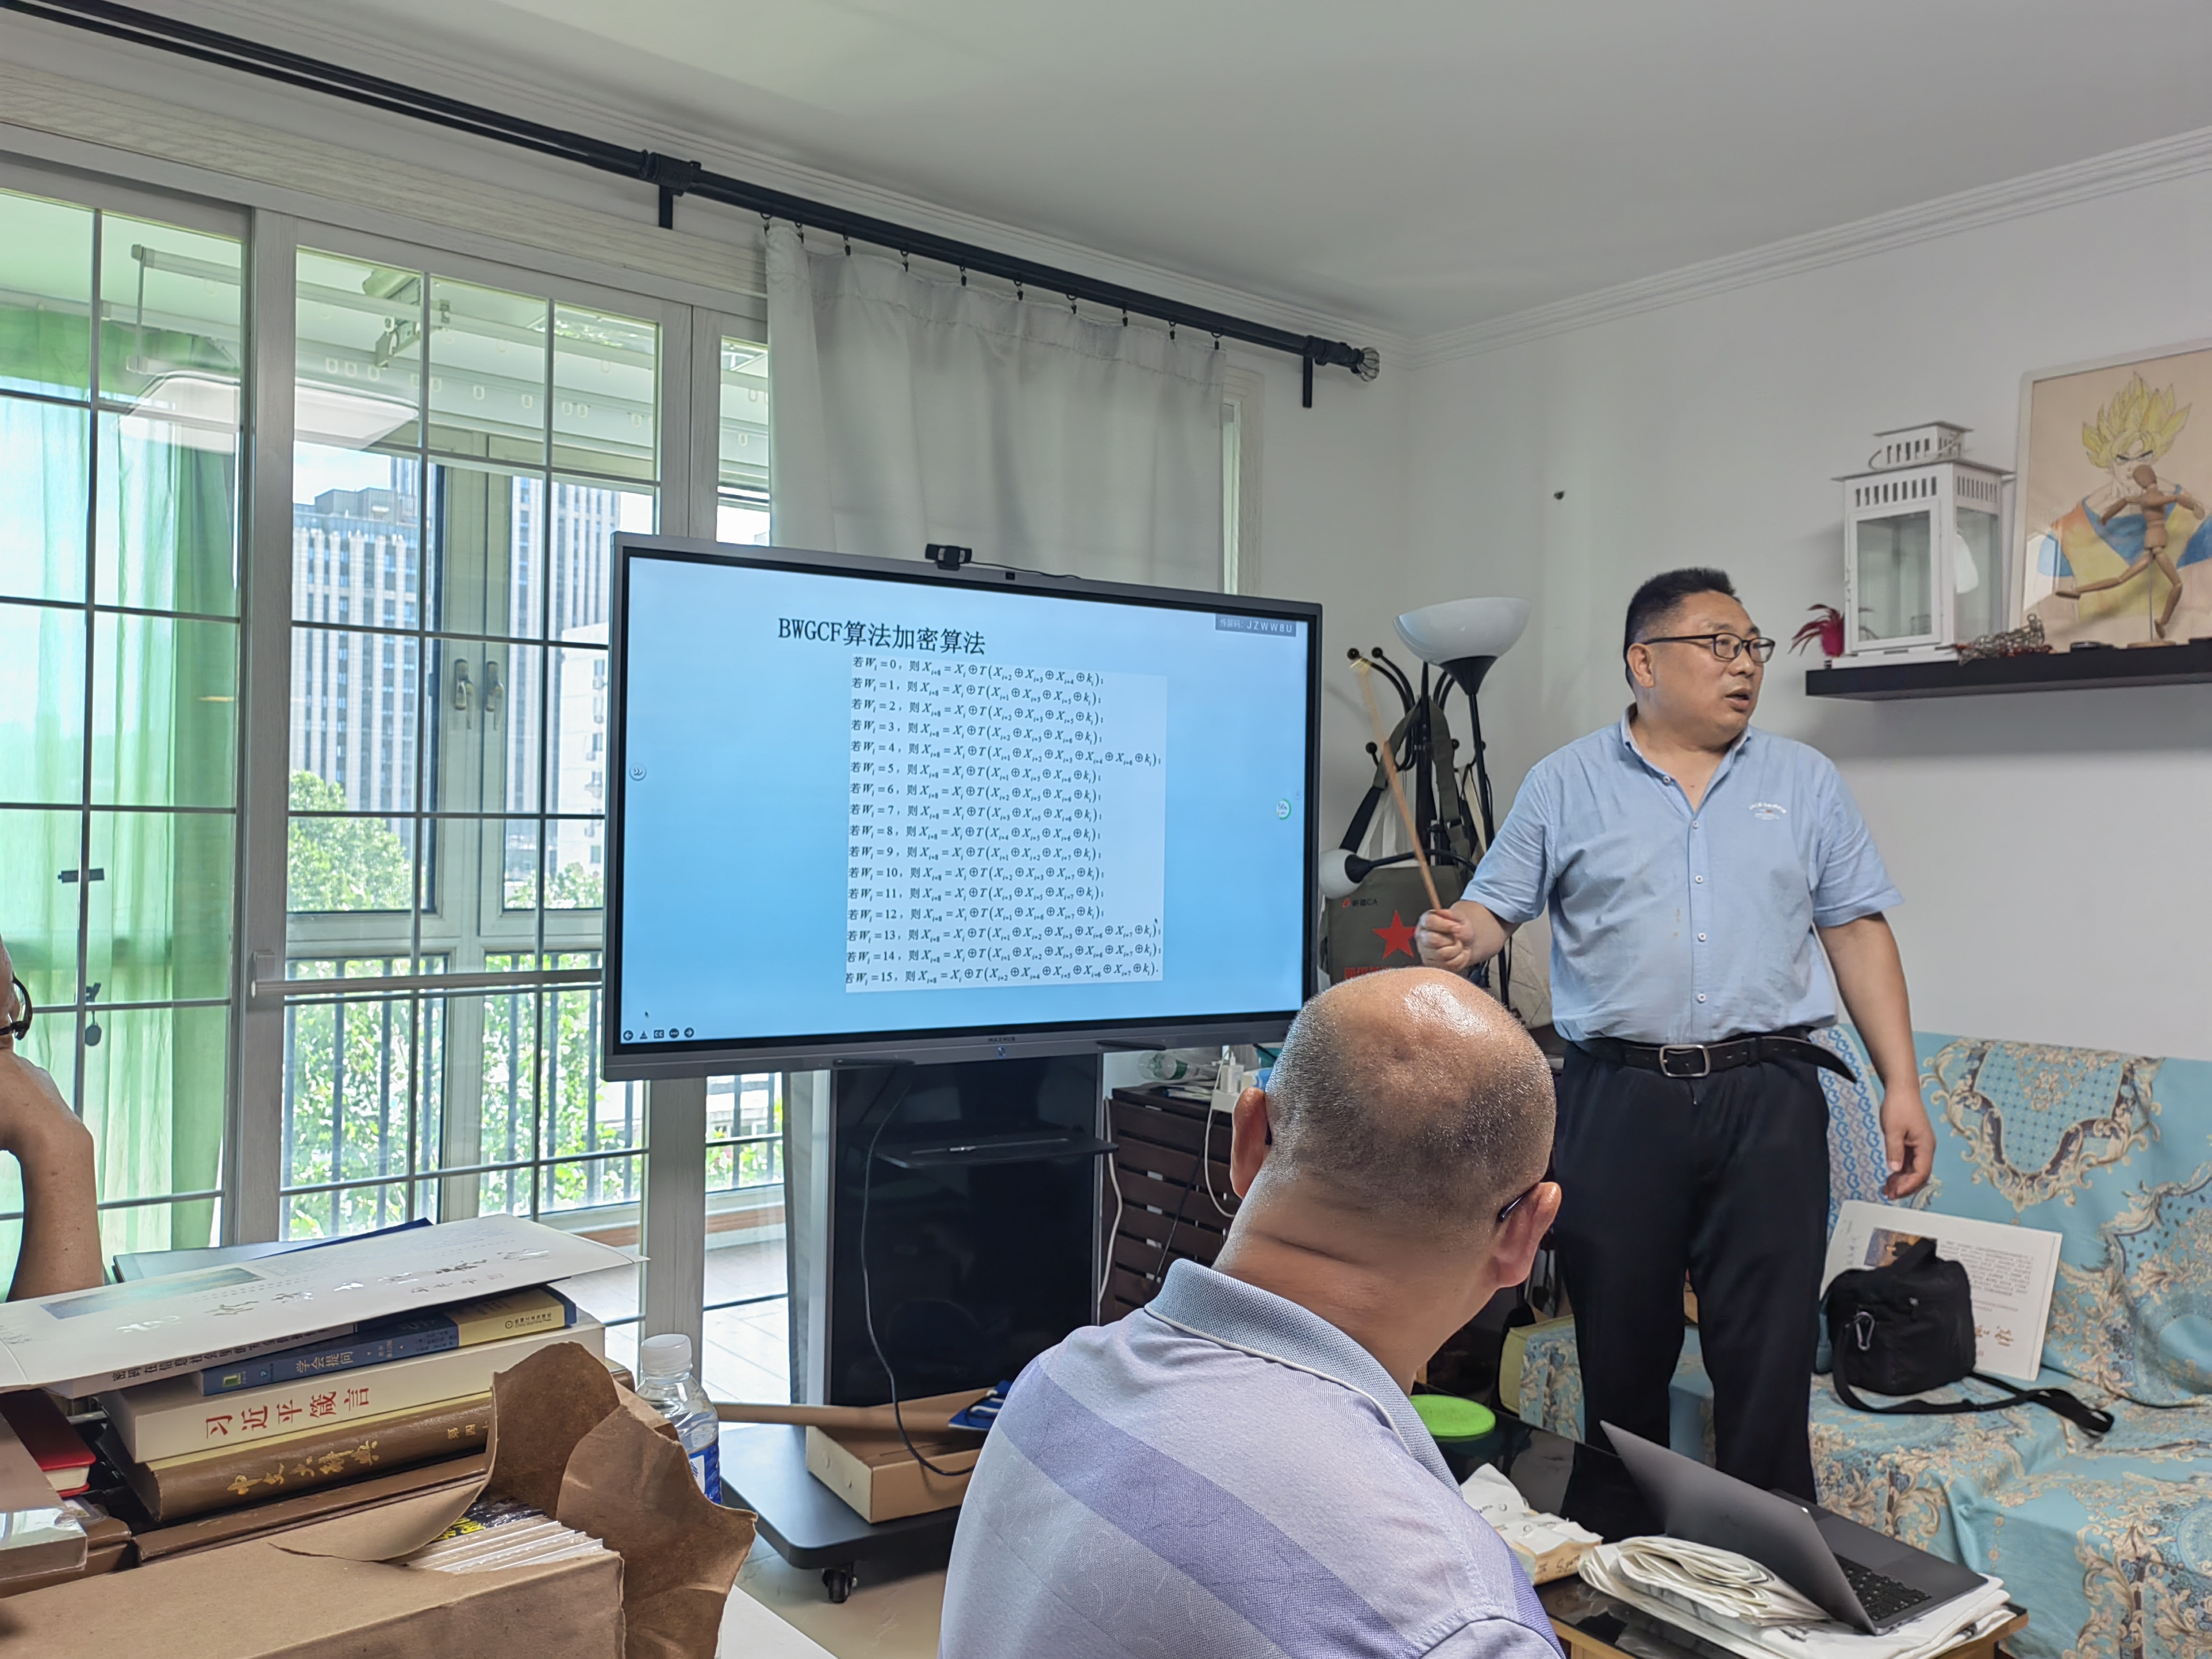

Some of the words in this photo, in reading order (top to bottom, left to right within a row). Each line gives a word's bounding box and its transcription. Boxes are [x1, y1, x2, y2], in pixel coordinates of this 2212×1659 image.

[778, 617, 987, 655] BWGCF算法加密算法
[296, 1351, 354, 1373] 学会提问
[205, 1387, 369, 1440] 习近平箴言
